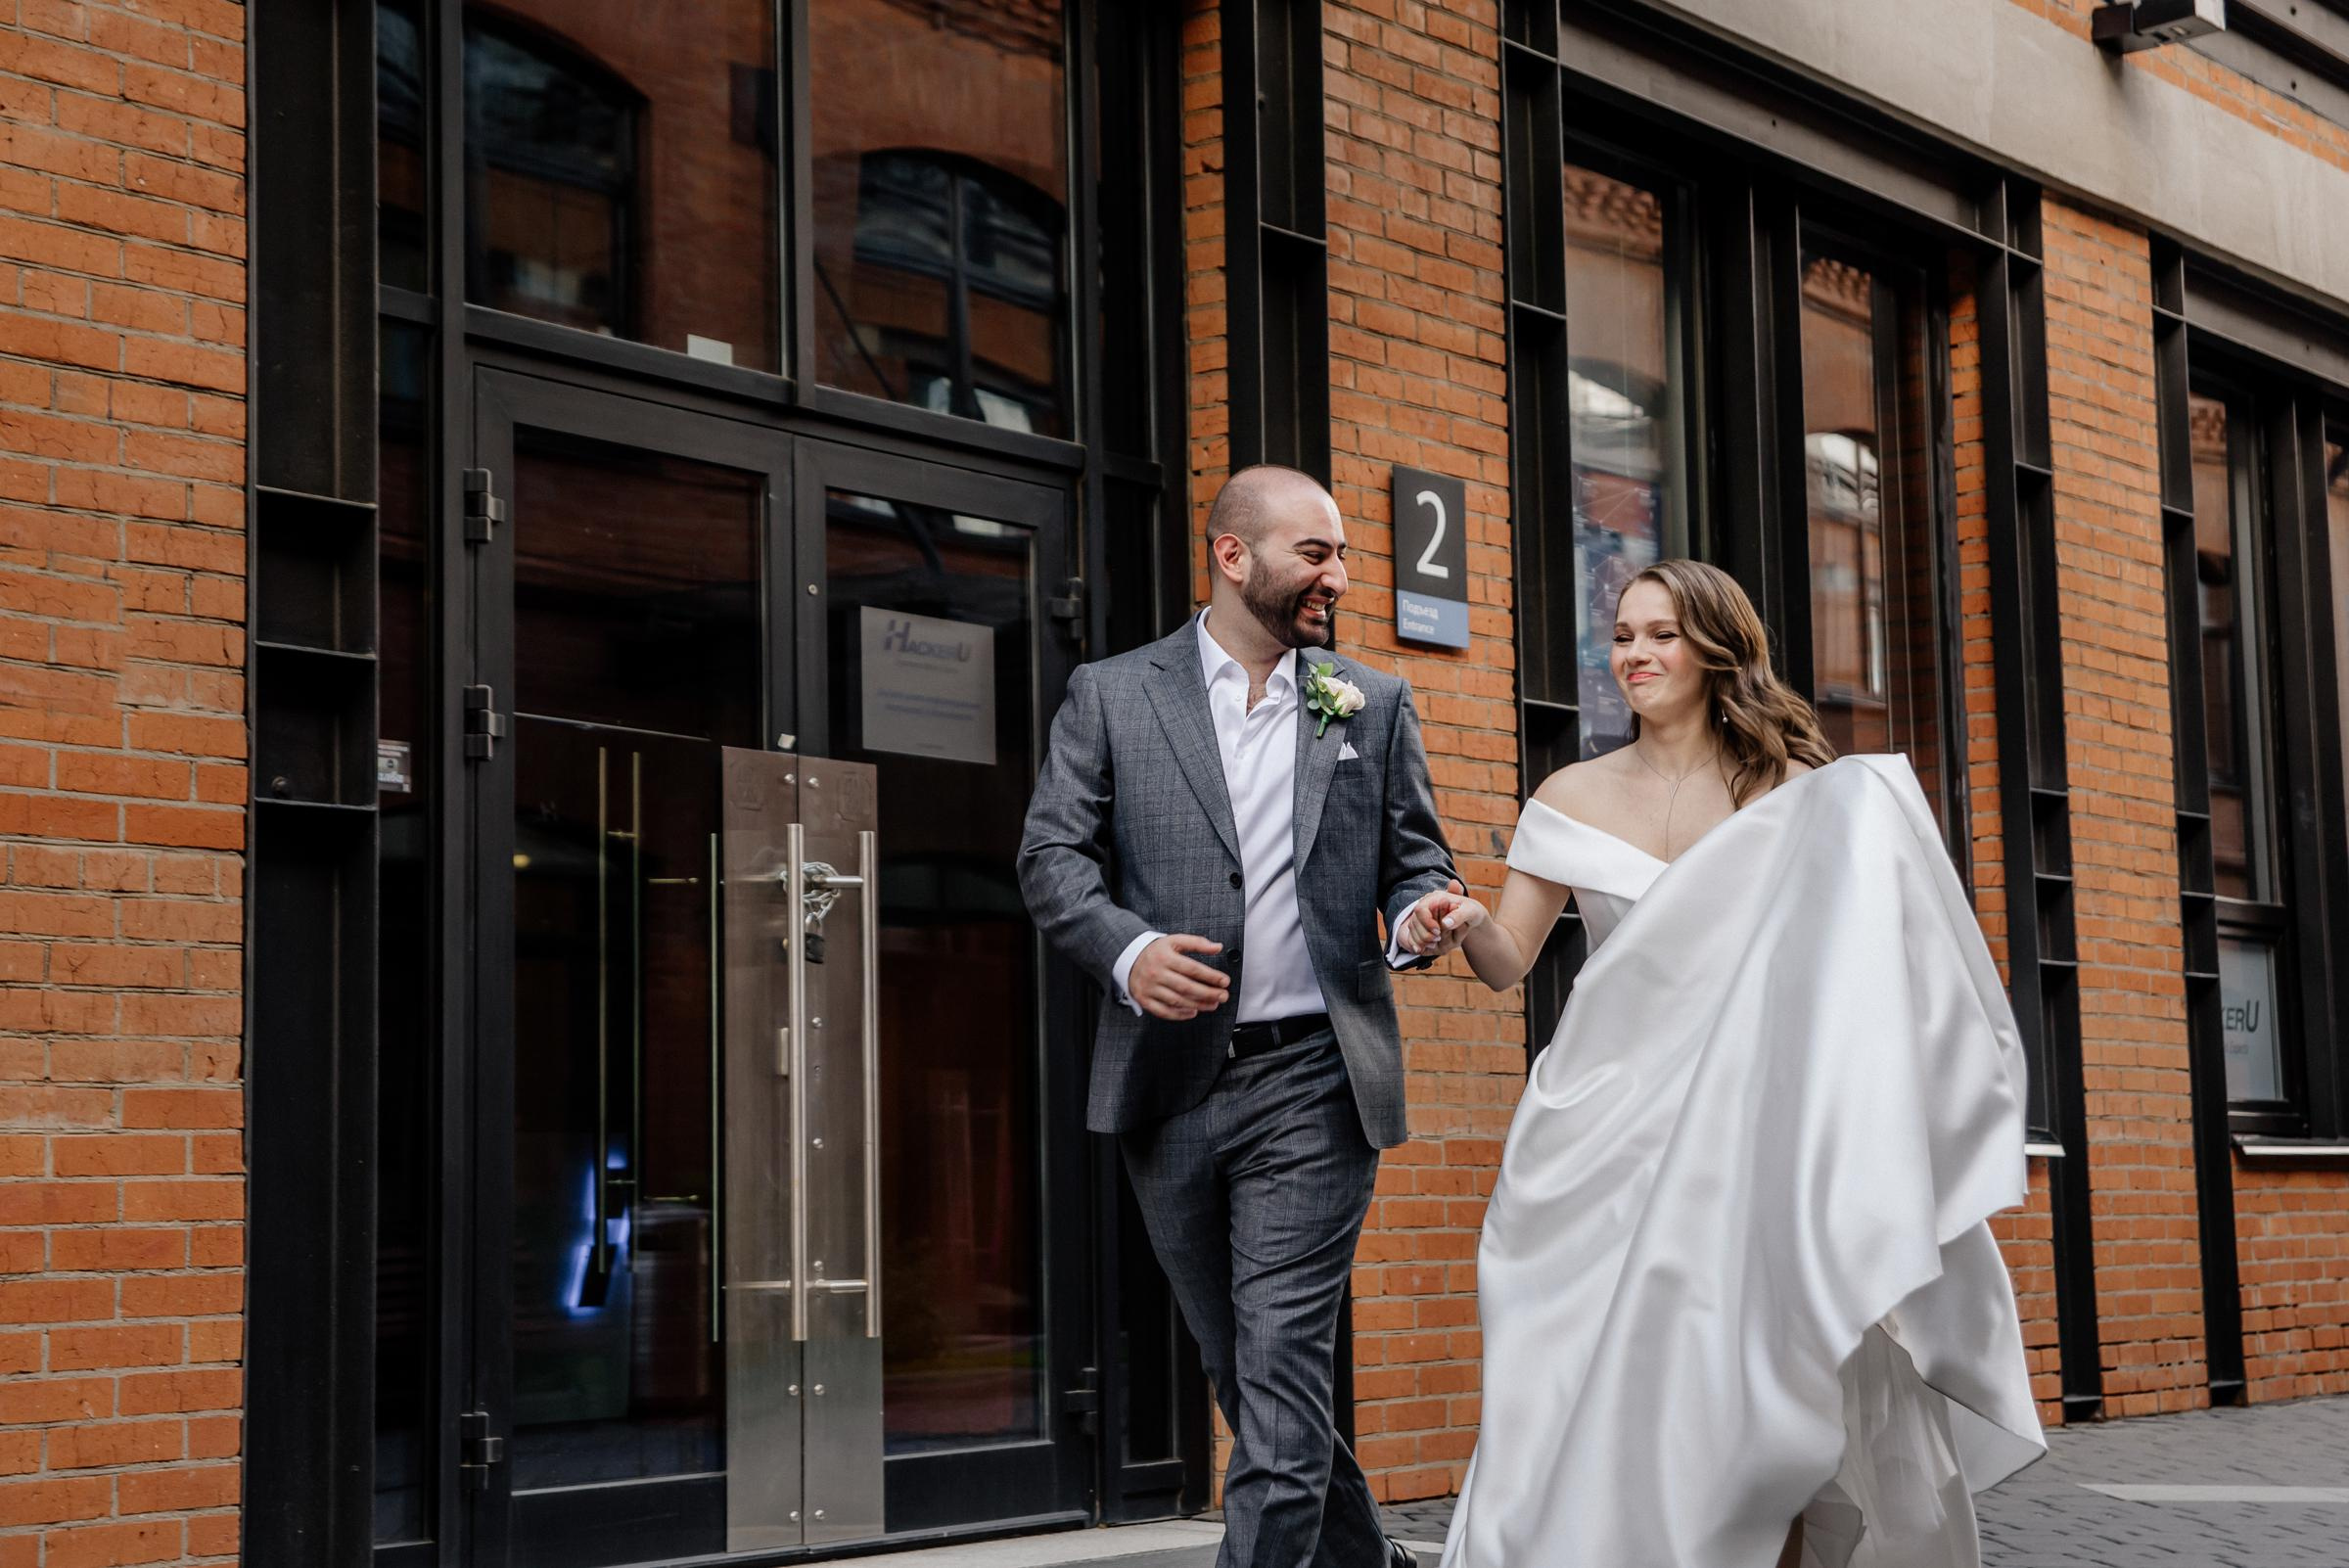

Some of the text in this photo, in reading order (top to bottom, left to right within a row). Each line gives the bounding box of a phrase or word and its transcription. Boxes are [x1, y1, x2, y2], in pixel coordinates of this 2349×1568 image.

[1416, 490, 1449, 578] 2
[1403, 618, 1435, 635] Entrance
[2222, 999, 2260, 1033] ERU
